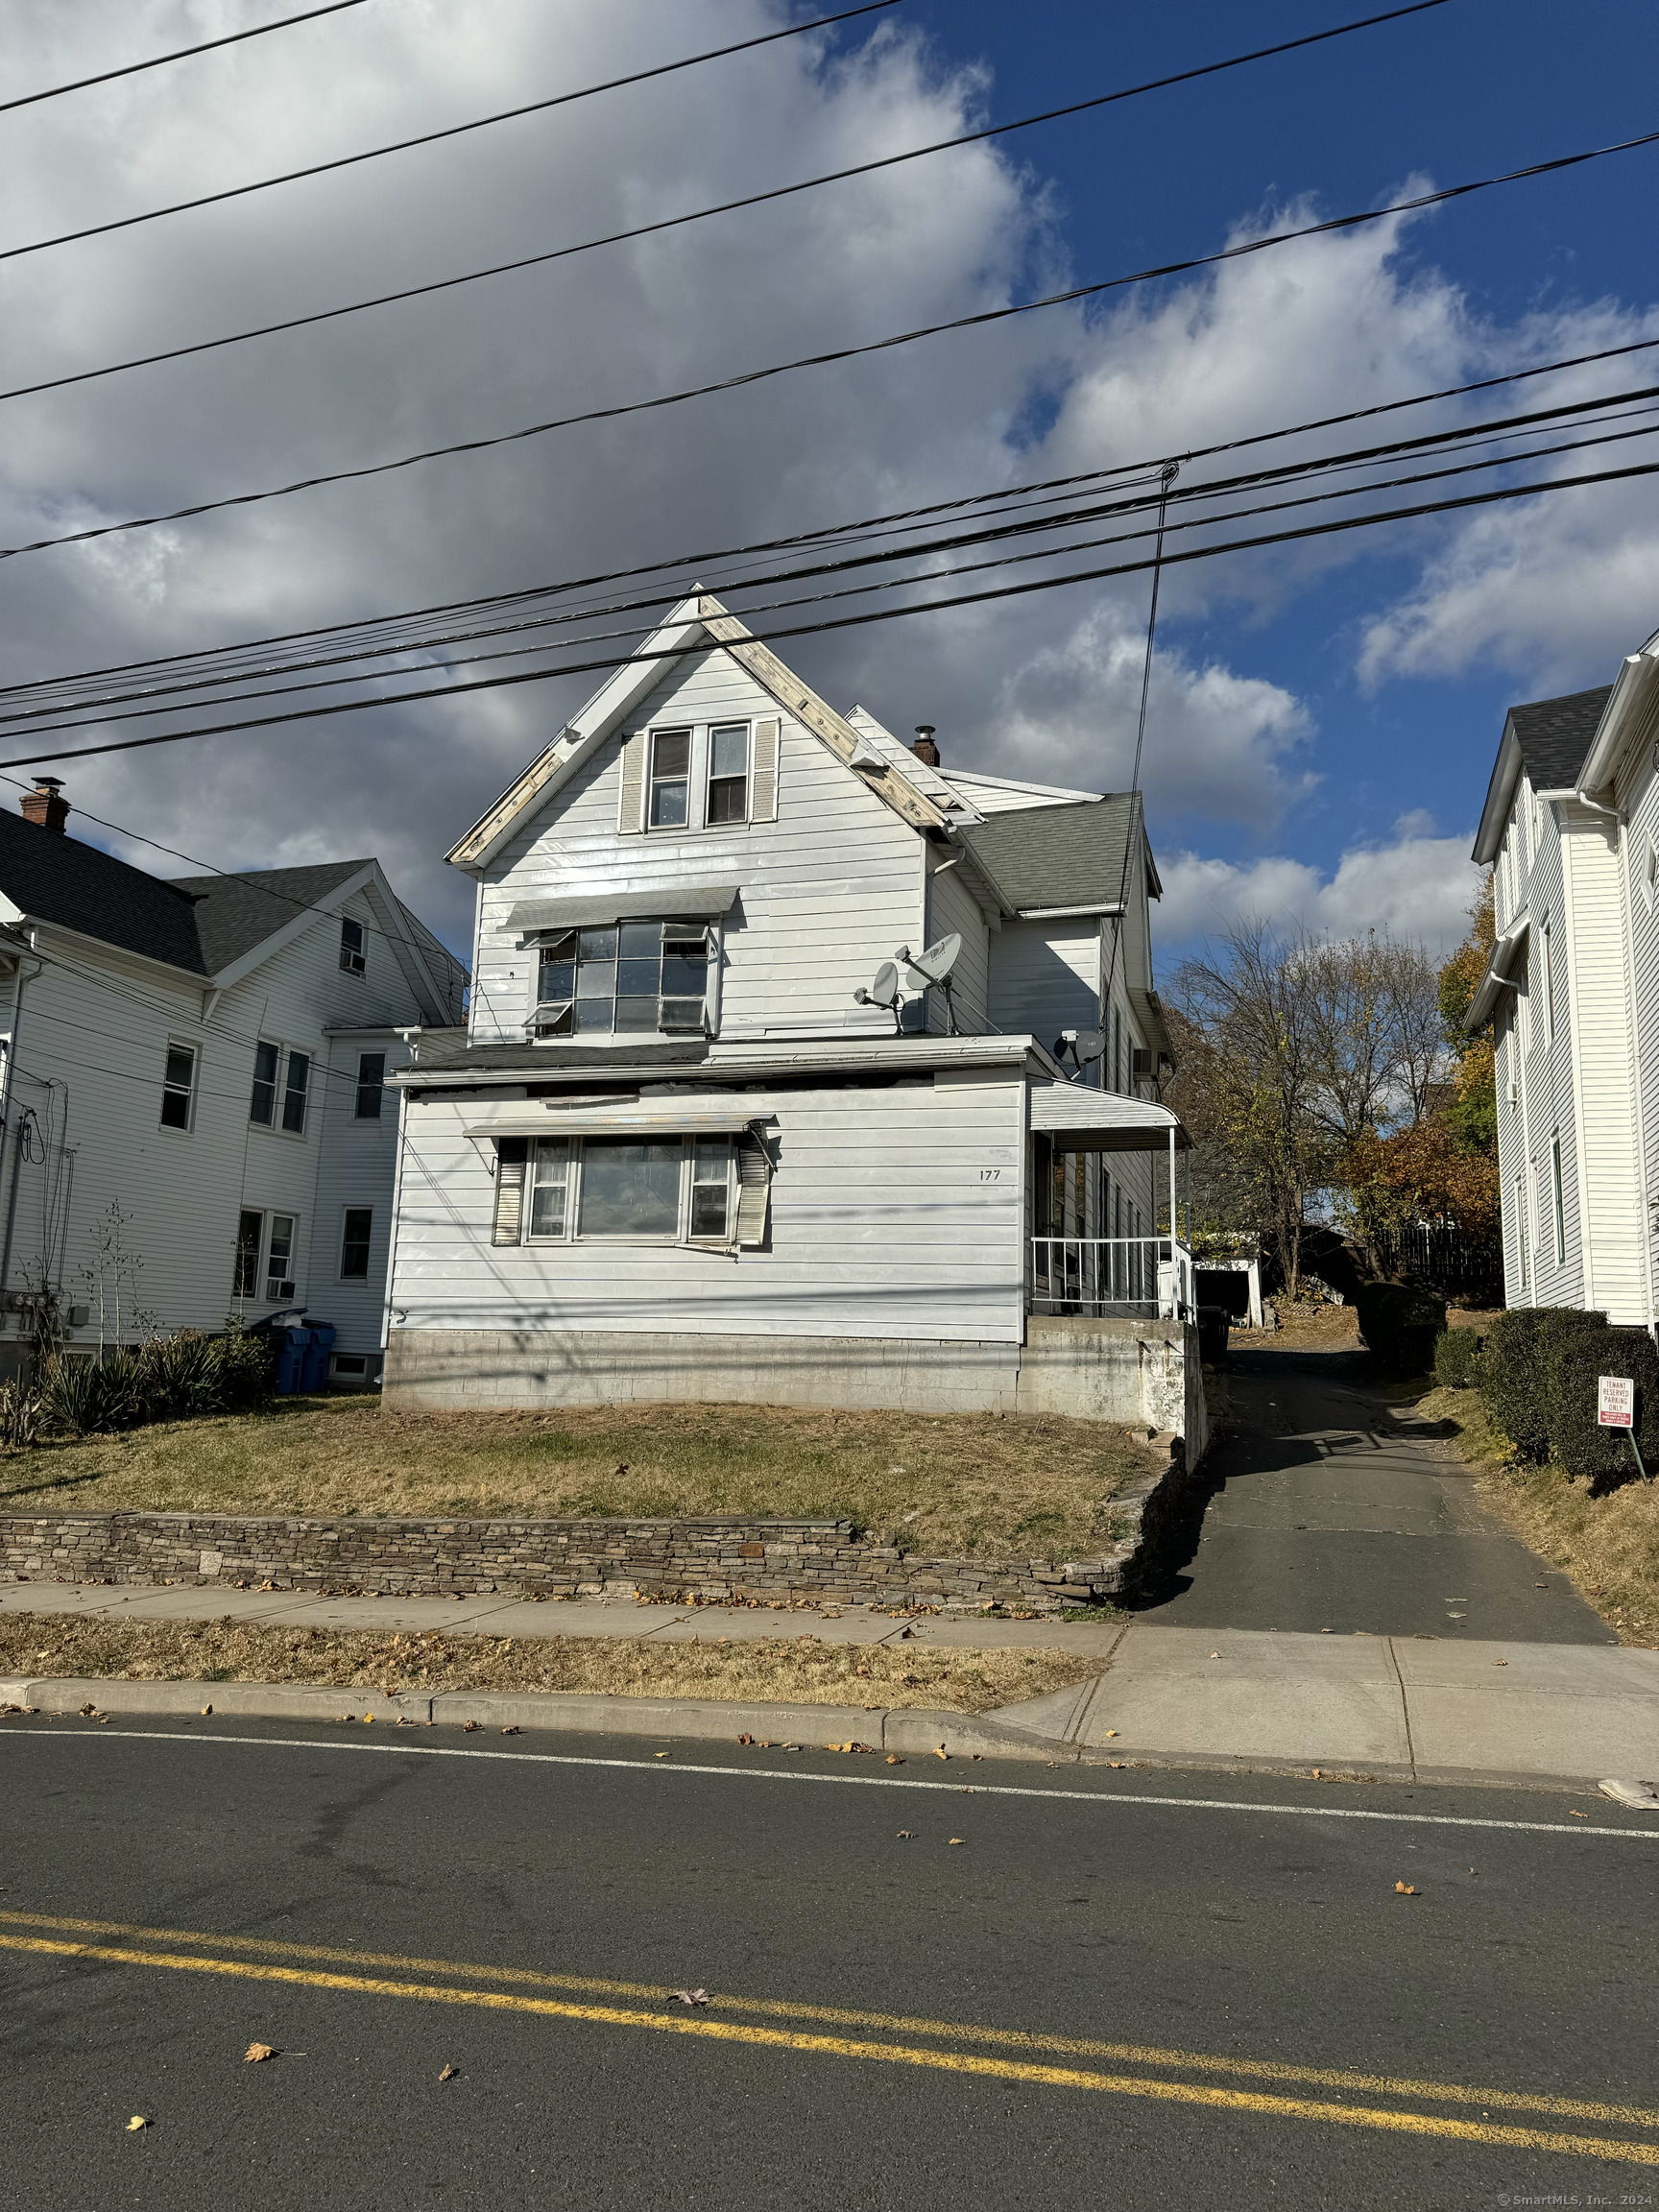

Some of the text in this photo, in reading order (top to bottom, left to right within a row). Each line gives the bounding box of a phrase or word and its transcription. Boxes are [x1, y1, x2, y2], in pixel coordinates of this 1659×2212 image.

[980, 1169, 1000, 1181] 177
[1607, 1381, 1626, 1389] TENANT
[1603, 1388, 1629, 1397] RESERVED
[1604, 1396, 1628, 1405] PARKING
